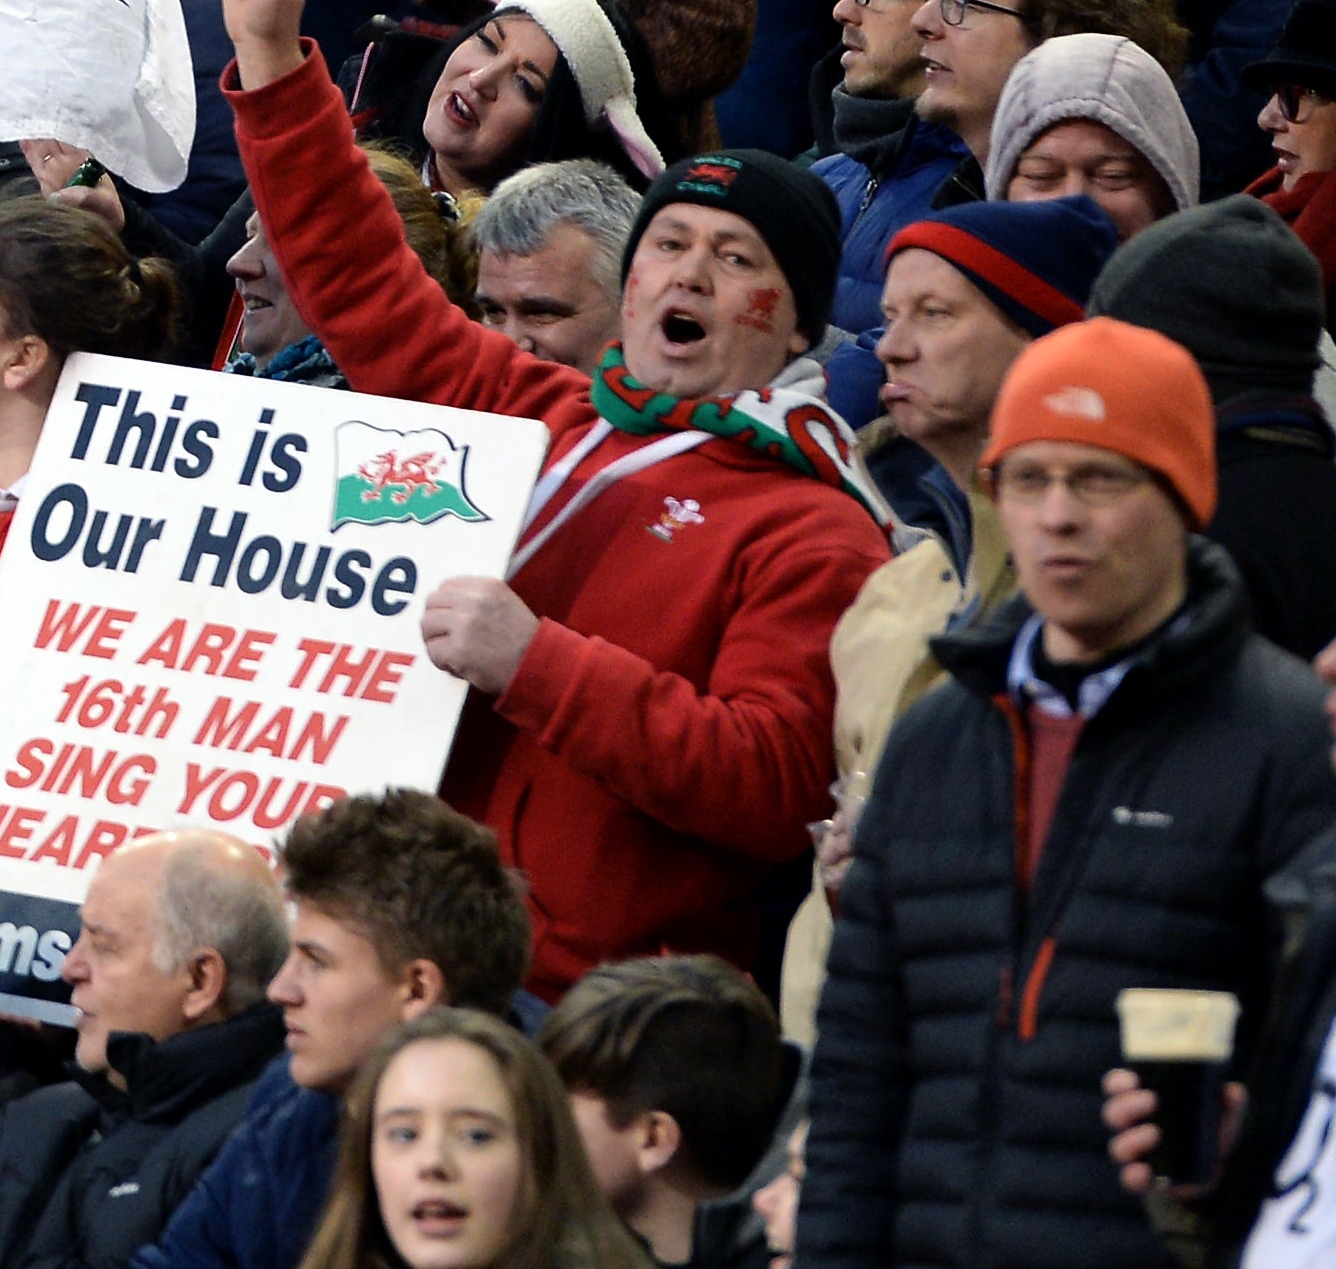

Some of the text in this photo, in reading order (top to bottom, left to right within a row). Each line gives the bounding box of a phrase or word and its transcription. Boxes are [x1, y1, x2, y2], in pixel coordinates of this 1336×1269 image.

[70, 382, 307, 493] This is
[30, 483, 417, 617] Our House
[35, 600, 415, 703] WE ARE THE
[57, 675, 348, 765] 16th MAN
[6, 739, 157, 806] SING
